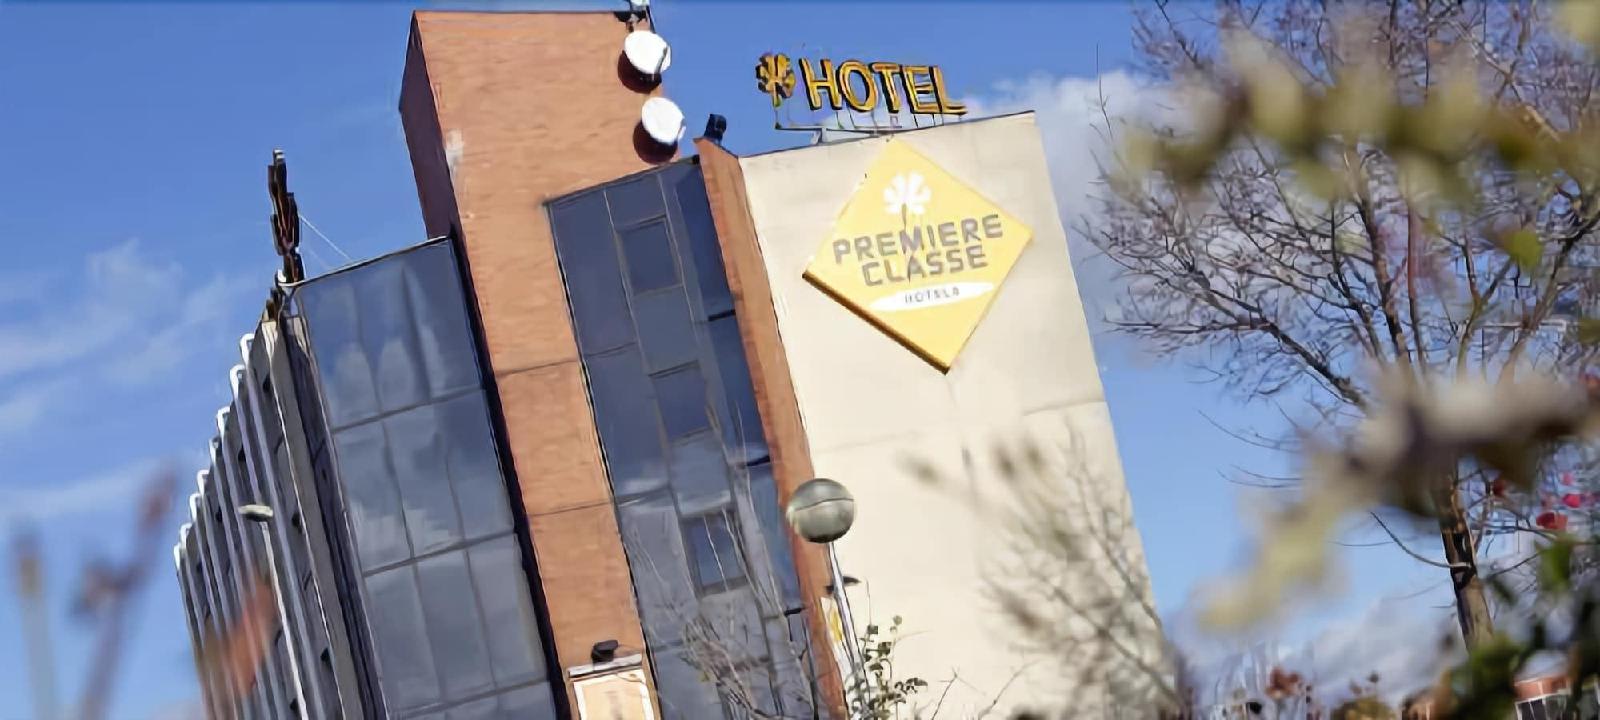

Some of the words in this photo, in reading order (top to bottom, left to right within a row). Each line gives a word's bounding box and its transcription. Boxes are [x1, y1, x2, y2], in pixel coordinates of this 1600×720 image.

[799, 57, 967, 115] HOTEL
[832, 214, 1003, 264] PREMIERE
[862, 245, 988, 286] CLASSE
